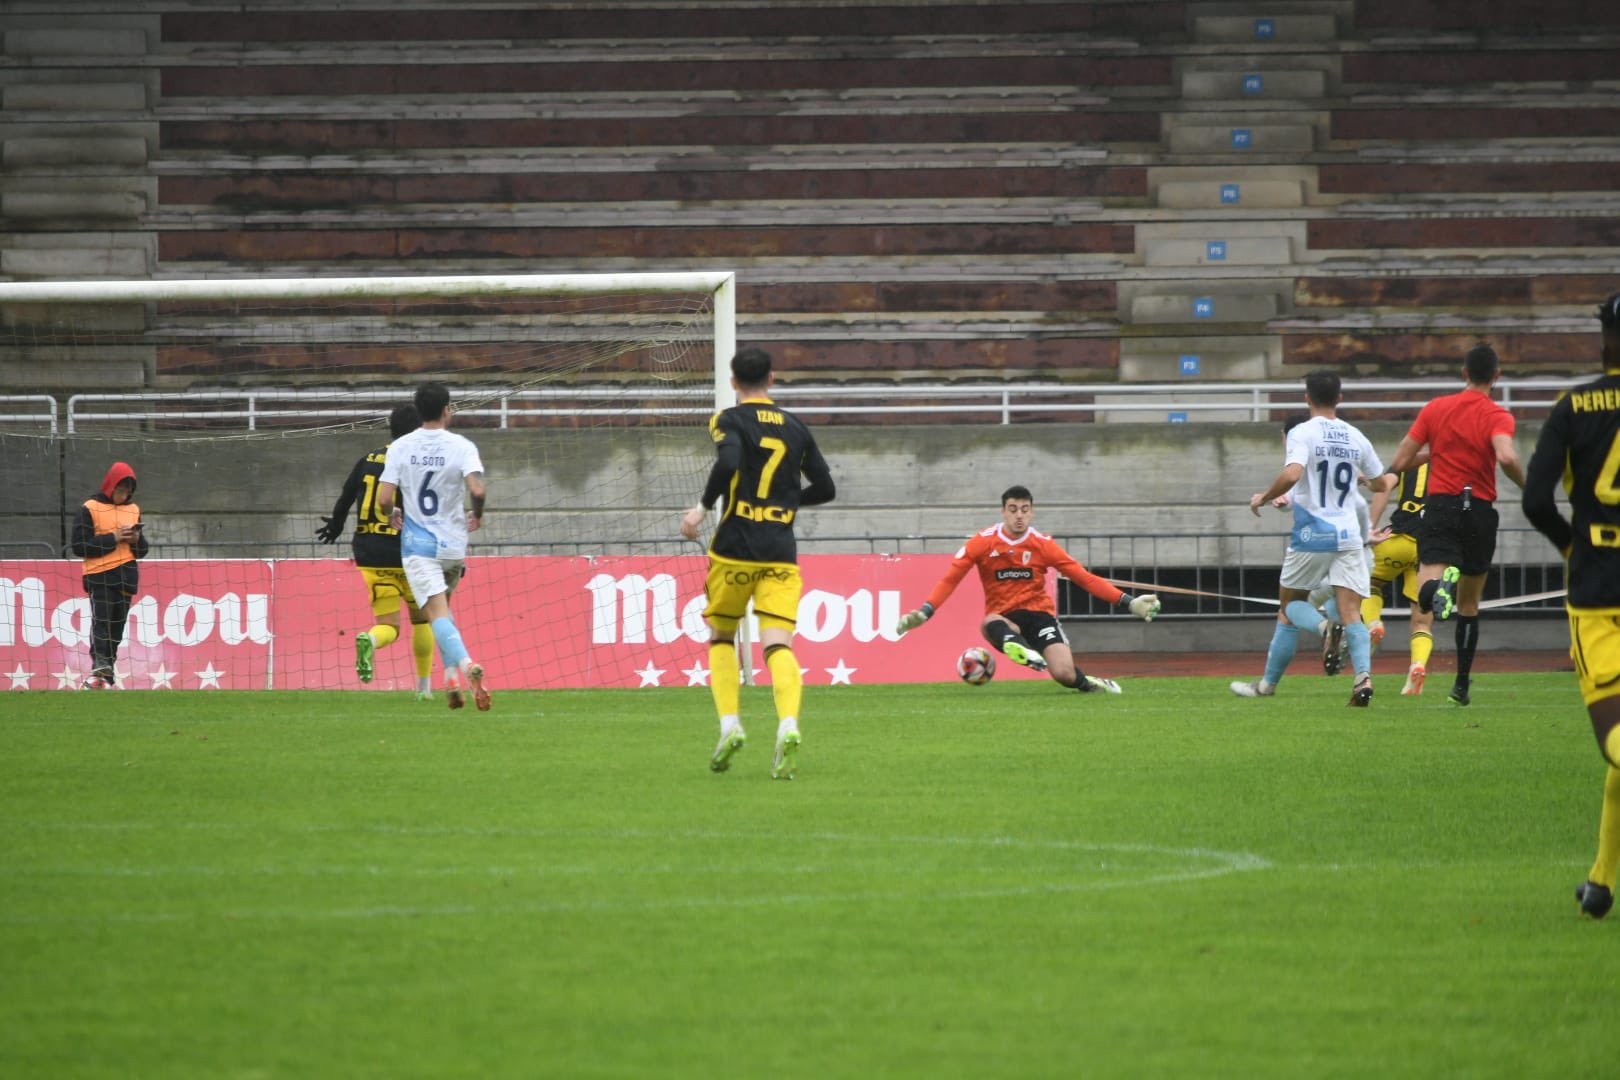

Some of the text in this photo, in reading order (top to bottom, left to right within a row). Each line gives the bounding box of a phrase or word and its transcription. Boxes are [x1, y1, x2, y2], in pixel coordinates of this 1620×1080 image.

[756, 409, 785, 425] IZAN
[1322, 430, 1350, 442] JAIME
[410, 455, 446, 466] D. SOTO
[1315, 446, 1360, 460] DE VICENTE
[756, 436, 787, 500] 7
[418, 471, 439, 517] 6
[1316, 459, 1353, 509] 19
[736, 500, 796, 524] DIGI
[997, 570, 1031, 579] Lenovo
[584, 573, 910, 644] Mou
